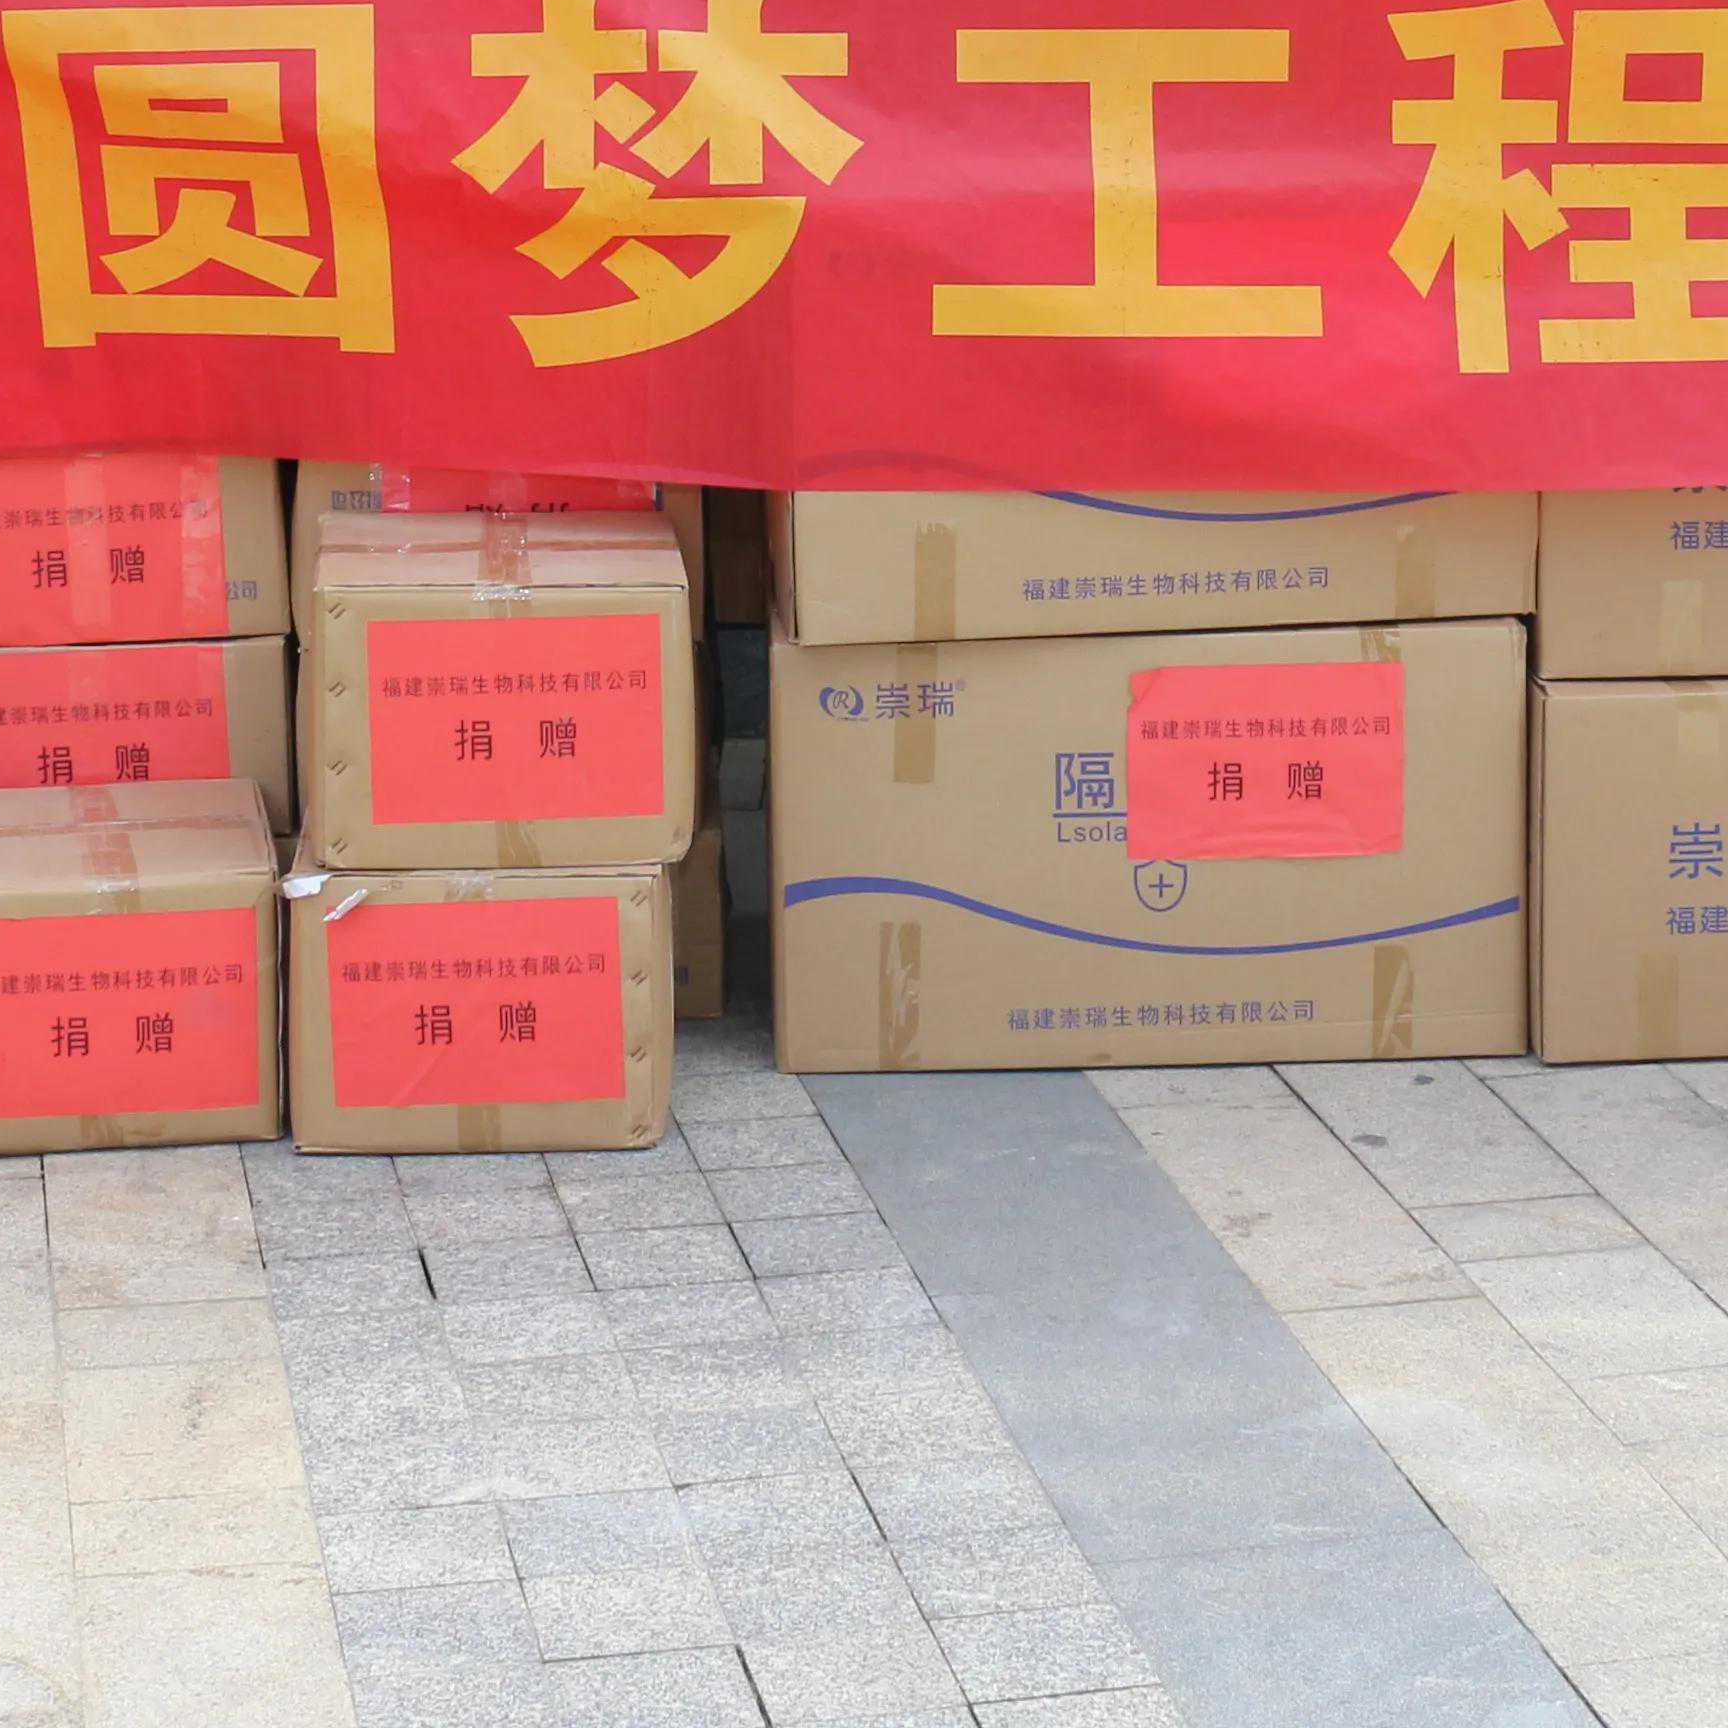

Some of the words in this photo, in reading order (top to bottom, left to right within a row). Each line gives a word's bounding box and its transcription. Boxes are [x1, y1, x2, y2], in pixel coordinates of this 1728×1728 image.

[32, 544, 145, 589] 捐赠
[1022, 566, 1329, 602] 福建崇瑞生物科技有限公司
[383, 669, 648, 698] 福建崇瑞生物科技有限公司
[874, 680, 956, 720] 崇瑞
[455, 717, 578, 762] 捐赠
[1140, 715, 1392, 742] 福建崇瑞生物科技有限公司
[37, 742, 151, 785] 捐赠
[1207, 762, 1325, 802] 捐赠
[341, 952, 607, 983] 福建崇瑞生物科技有限公司
[51, 1011, 174, 1057] 捐赠
[414, 1001, 537, 1047] 捐赠
[1007, 999, 1316, 1032] 福建崇瑞生物科技有限公司
